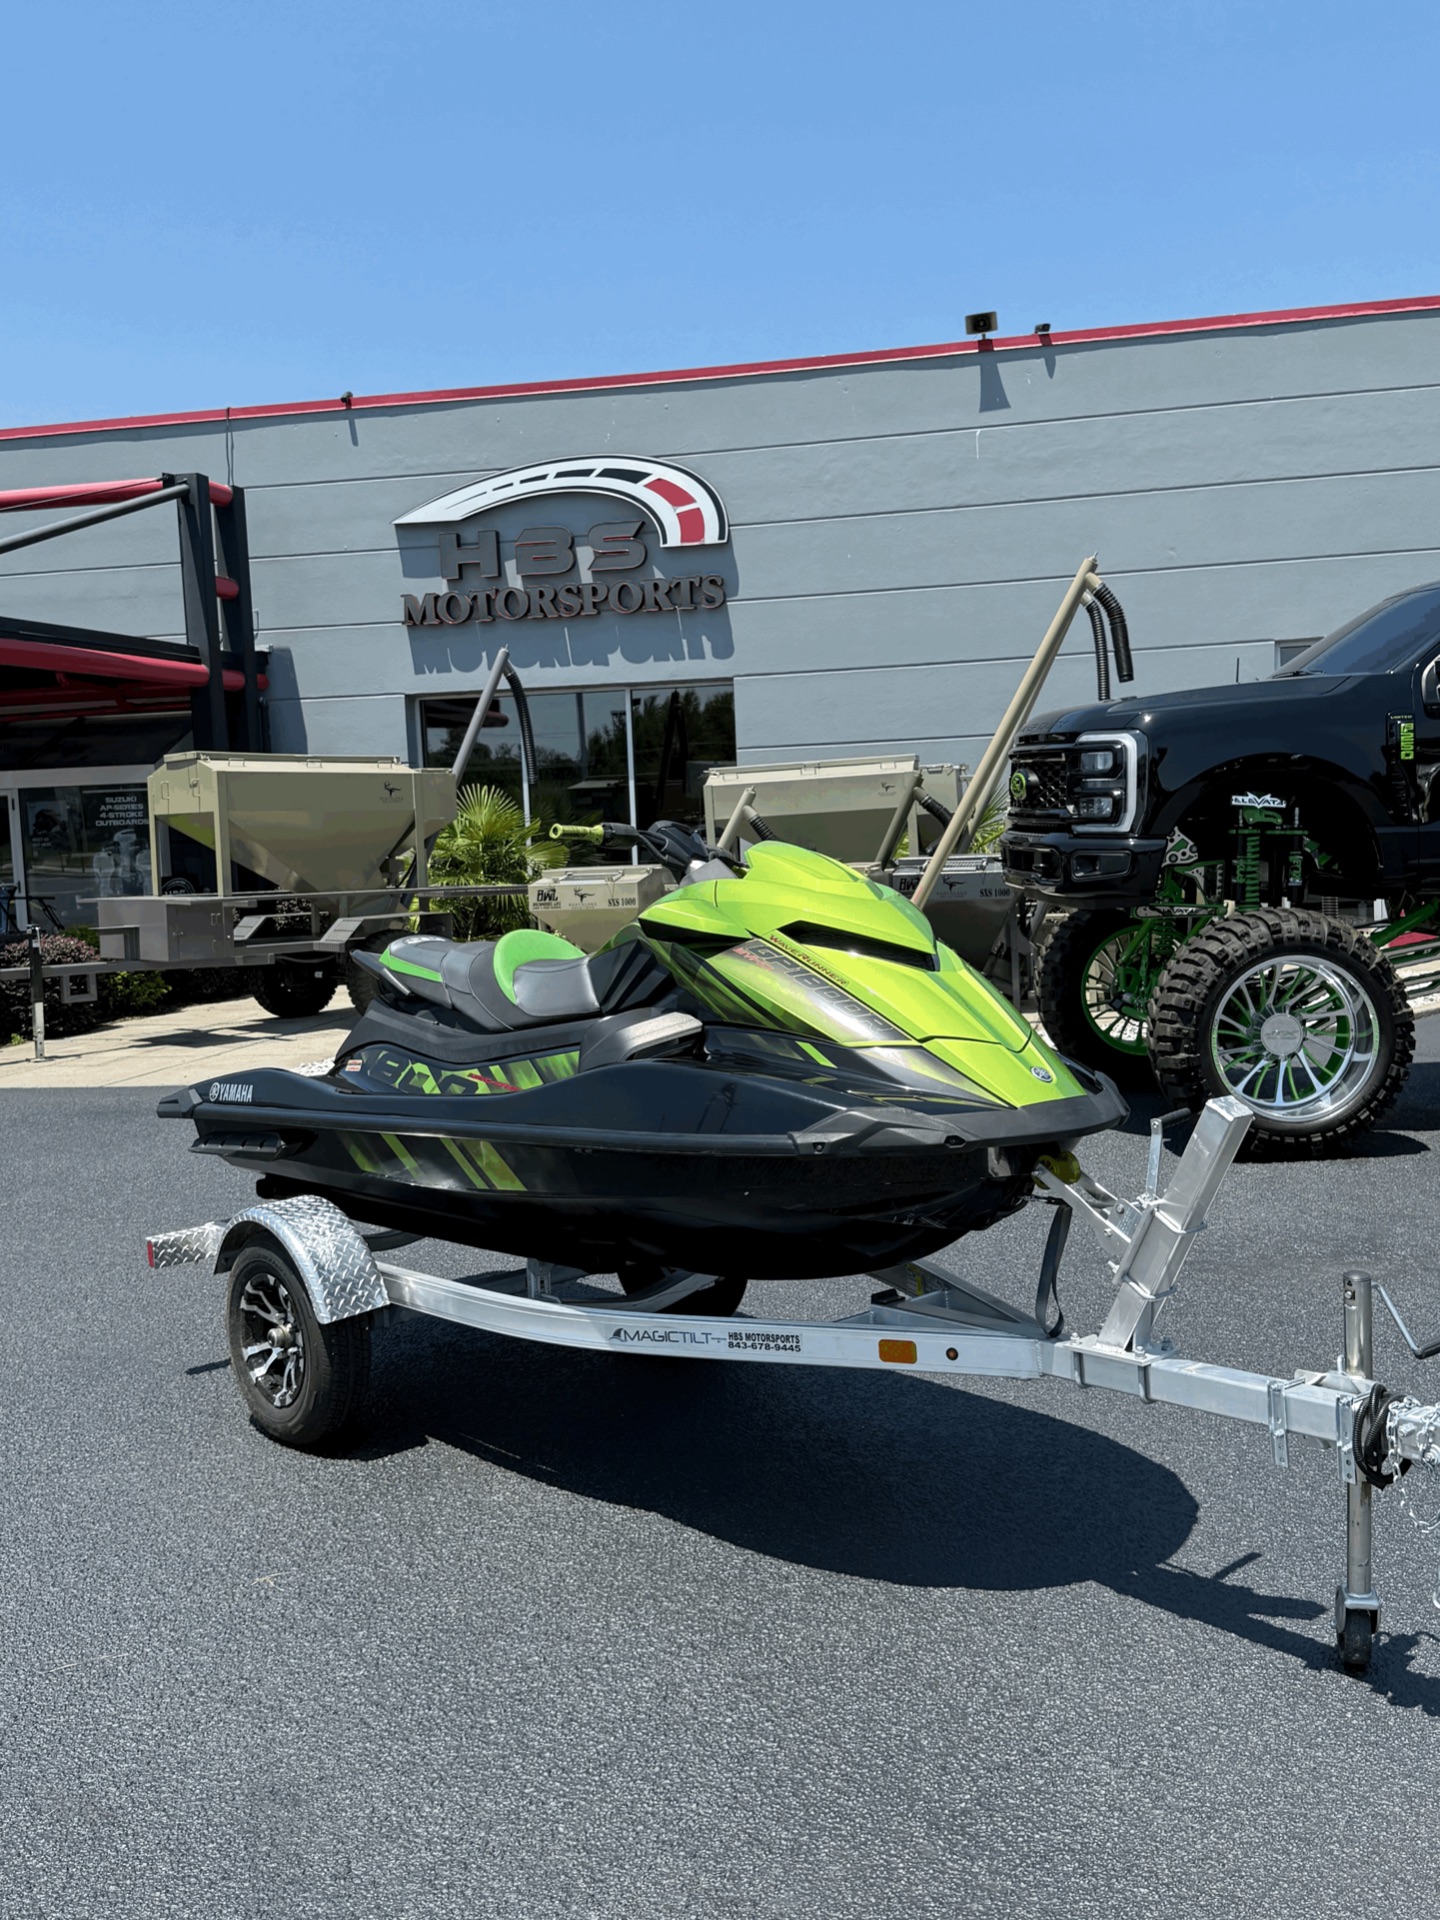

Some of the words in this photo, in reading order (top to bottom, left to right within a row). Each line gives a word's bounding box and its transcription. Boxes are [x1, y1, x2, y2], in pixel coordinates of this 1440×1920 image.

[438, 520, 647, 580] HBS
[400, 574, 727, 626] MOTORSPORTS
[100, 803, 144, 811] AP-SERIES
[100, 811, 144, 819] 4-STROKE
[95, 818, 150, 827] OUTBOARDS
[899, 877, 920, 891] BW
[994, 888, 1011, 898] 1000
[621, 897, 637, 907] 1000
[219, 1083, 253, 1102] YAMAHA
[623, 1329, 712, 1344] MAGICTILT
[728, 1331, 744, 1341] HBS
[745, 1332, 800, 1344] MOTORSPORTS
[727, 1341, 801, 1352] 843-678-9445
